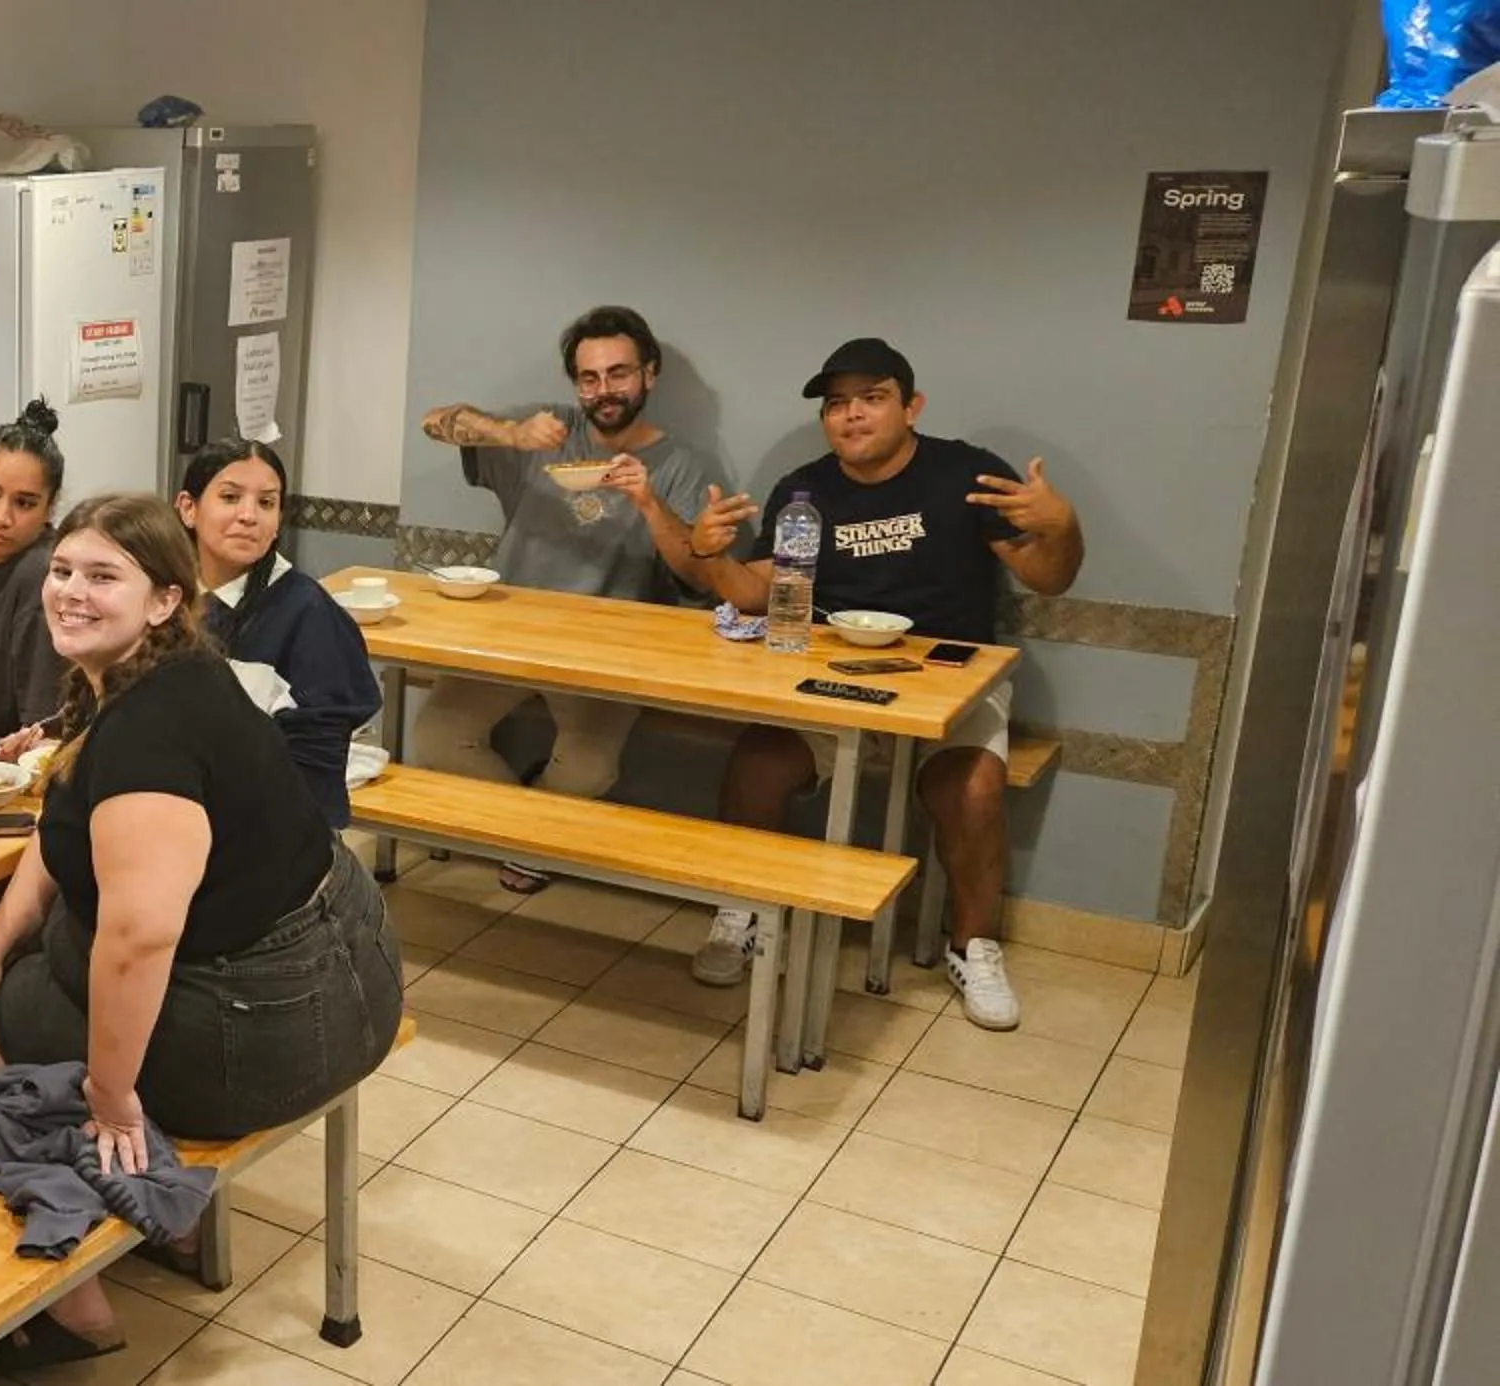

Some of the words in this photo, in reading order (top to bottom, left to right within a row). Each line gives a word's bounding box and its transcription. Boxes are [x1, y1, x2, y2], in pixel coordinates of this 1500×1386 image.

[1163, 188, 1245, 211] Spring
[833, 511, 927, 551] STRANGER
[850, 535, 913, 557] THINGS
